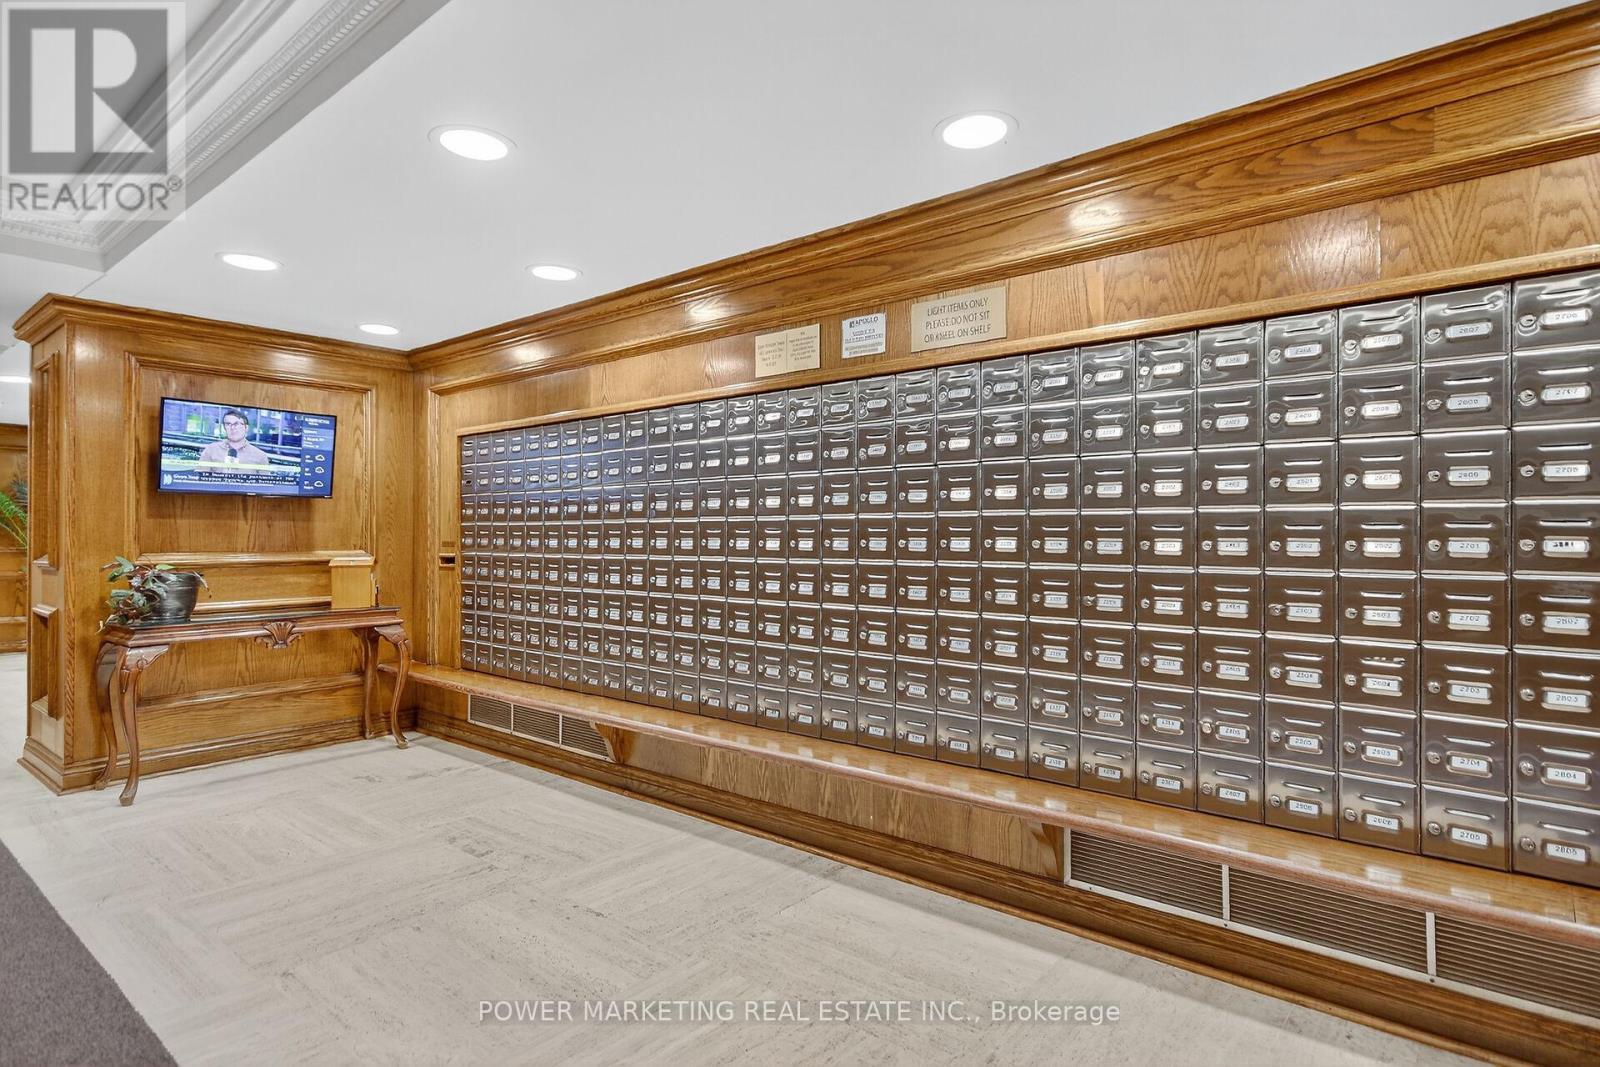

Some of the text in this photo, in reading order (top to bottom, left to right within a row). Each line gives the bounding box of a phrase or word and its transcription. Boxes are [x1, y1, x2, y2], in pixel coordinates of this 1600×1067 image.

[927, 297, 989, 317] LIGHT ITEMS ONLY
[925, 310, 990, 330] PLEASE DO NOT SIT
[935, 330, 956, 341] KNEEL
[957, 328, 969, 338] ON
[970, 323, 992, 336] SHELF
[1459, 686, 1480, 694] 2703
[1556, 694, 1579, 703] 2803
[1459, 758, 1480, 767] 2704
[1554, 770, 1577, 780] 2804
[1459, 831, 1480, 841] 2705
[1555, 846, 1578, 856] 2805
